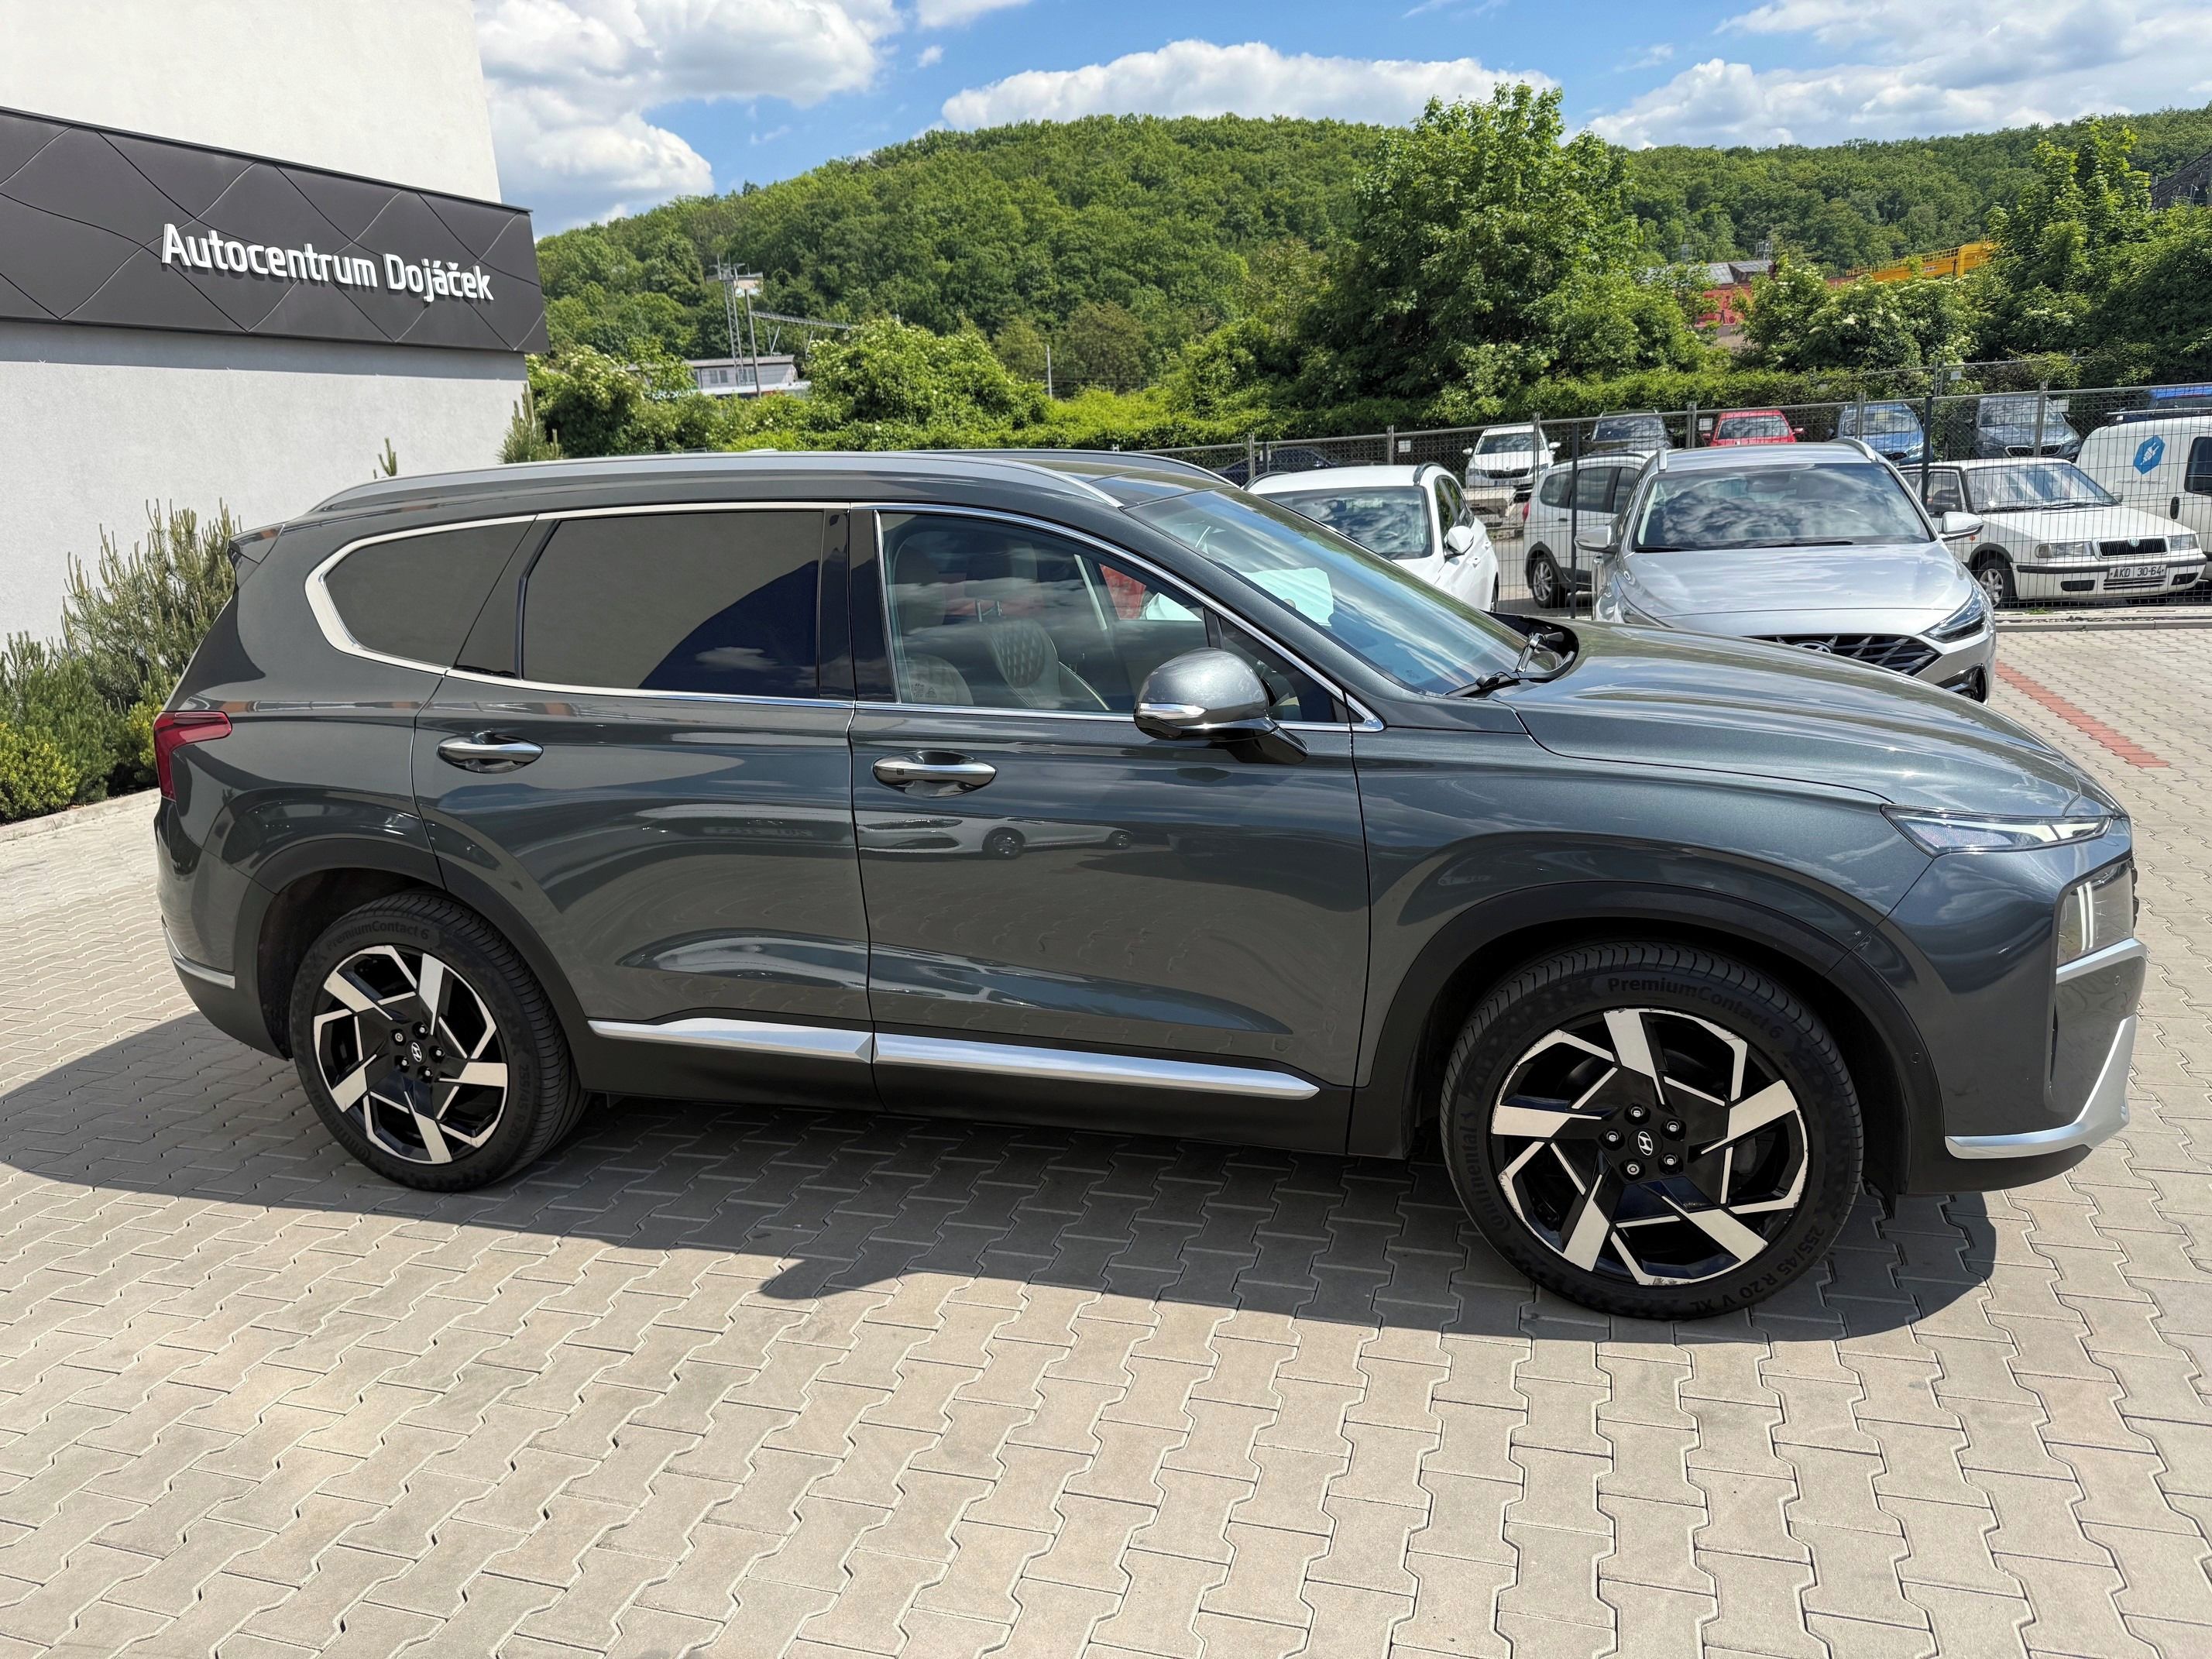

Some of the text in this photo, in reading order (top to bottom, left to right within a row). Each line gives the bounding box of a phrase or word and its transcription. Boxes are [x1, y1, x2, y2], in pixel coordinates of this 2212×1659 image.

[162, 223, 494, 303] Autocentrum Dojáček
[1607, 977, 1785, 1039] PremiumContact 6
[1777, 1225, 1826, 1276] 255/45
